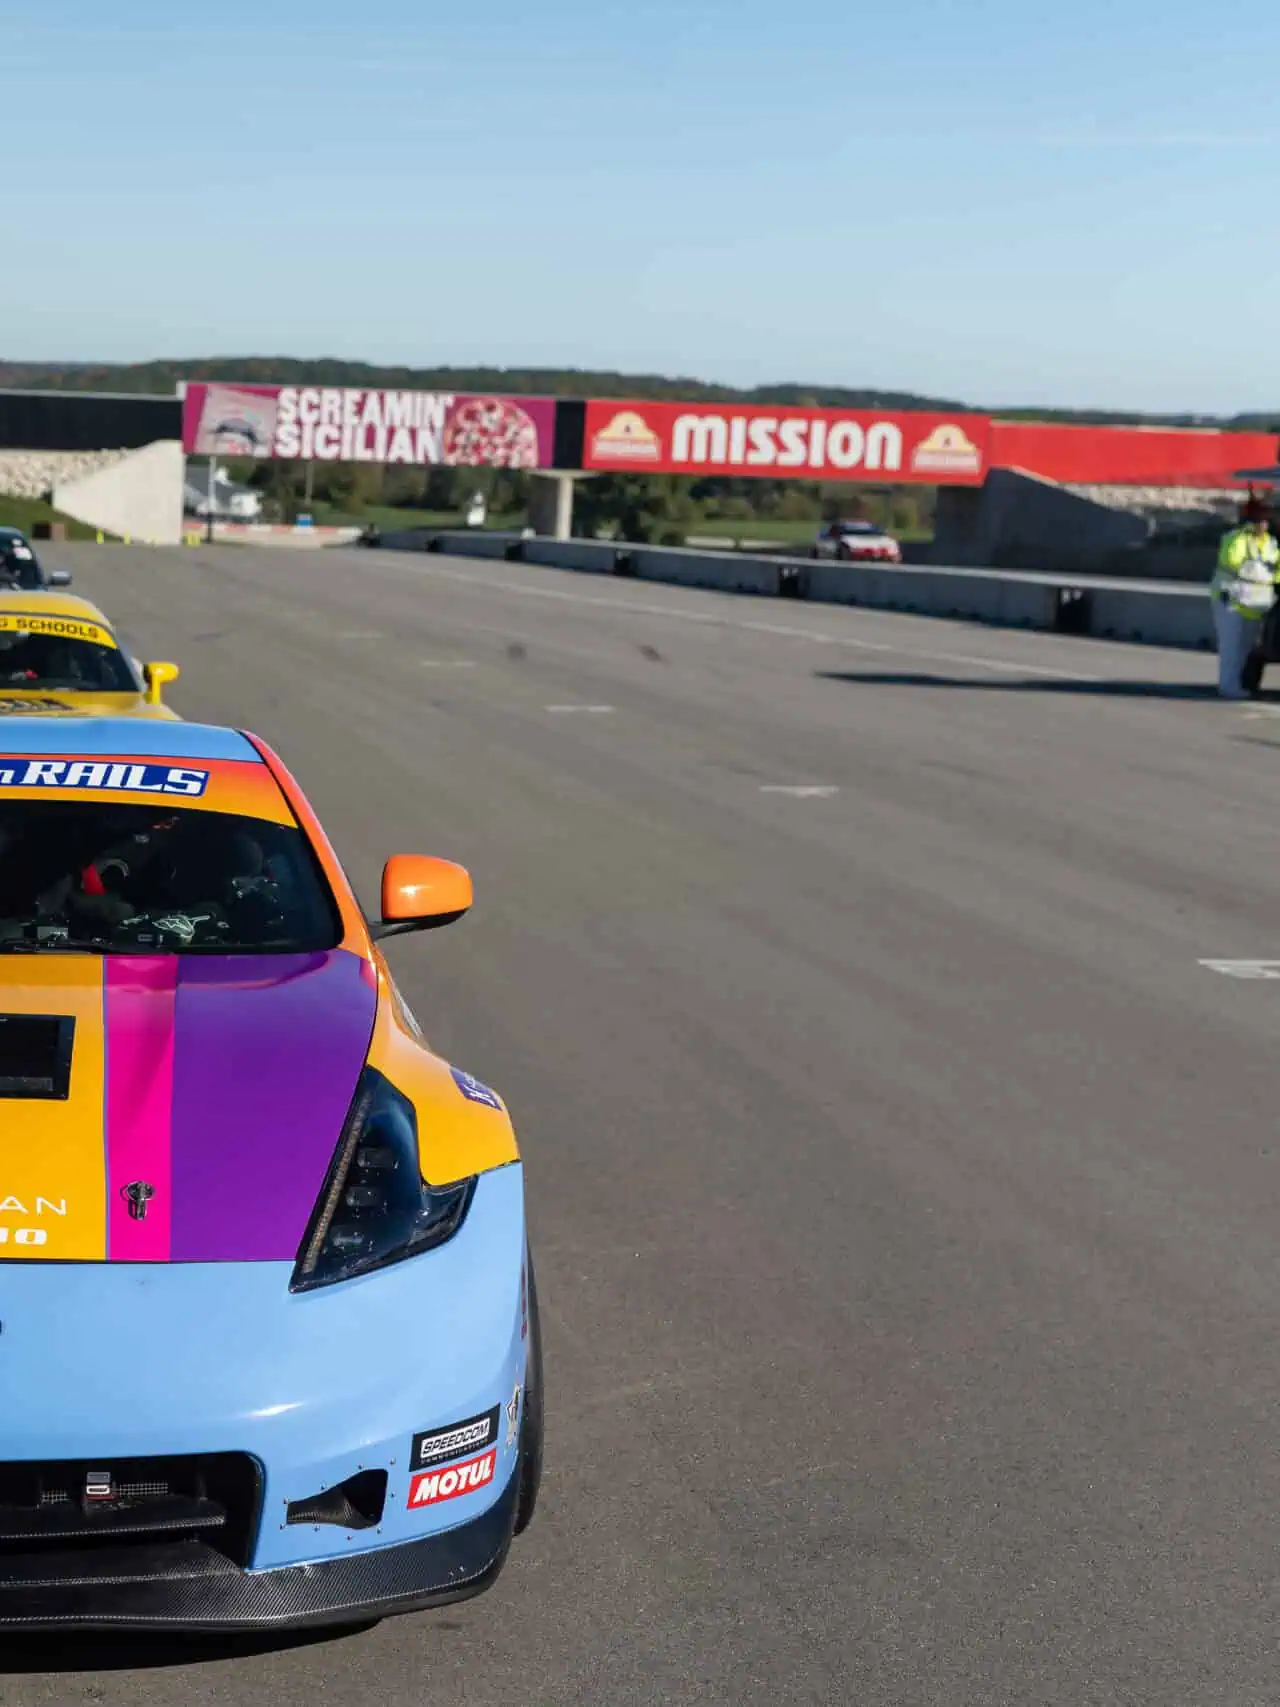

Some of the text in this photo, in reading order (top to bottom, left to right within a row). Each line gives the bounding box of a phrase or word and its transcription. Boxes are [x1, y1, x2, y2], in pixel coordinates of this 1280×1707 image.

[277, 387, 454, 430] SCREAMIN'
[275, 423, 442, 463] SICILIAN
[671, 413, 901, 470] MISSION
[16, 618, 100, 639] SCHOOLS
[18, 761, 206, 796] RAILS
[422, 1423, 489, 1454] SPEEDCOM
[413, 1456, 492, 1503] MOTUL
